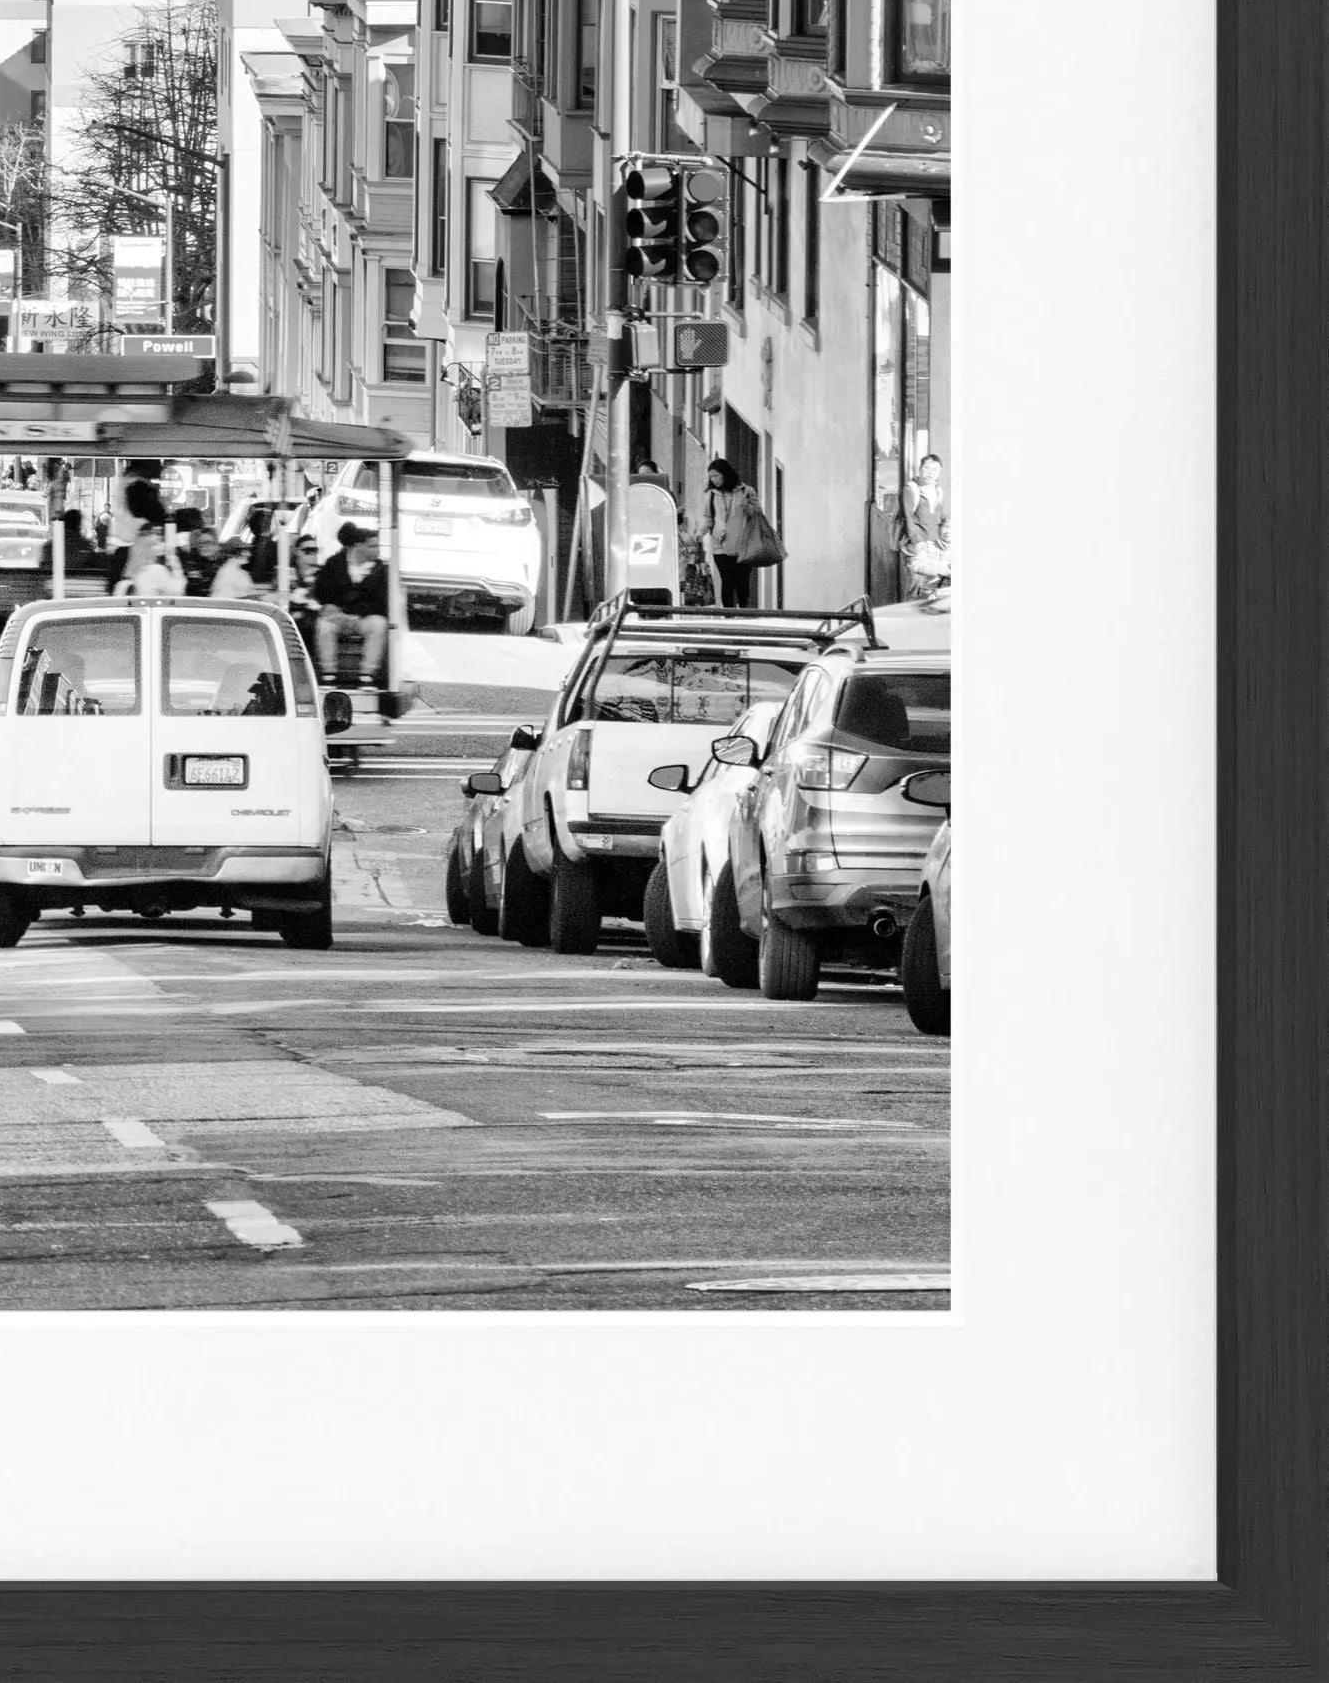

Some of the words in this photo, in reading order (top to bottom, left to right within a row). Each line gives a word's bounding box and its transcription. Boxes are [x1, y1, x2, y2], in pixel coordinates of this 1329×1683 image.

[23, 329, 38, 337] EW
[39, 329, 65, 338] WING
[488, 334, 499, 345] NO
[501, 335, 527, 344] PARKING
[142, 340, 194, 353] Powell
[494, 357, 522, 366] TUESDAY
[490, 379, 500, 390] 2
[230, 808, 292, 817] CHEVROLET
